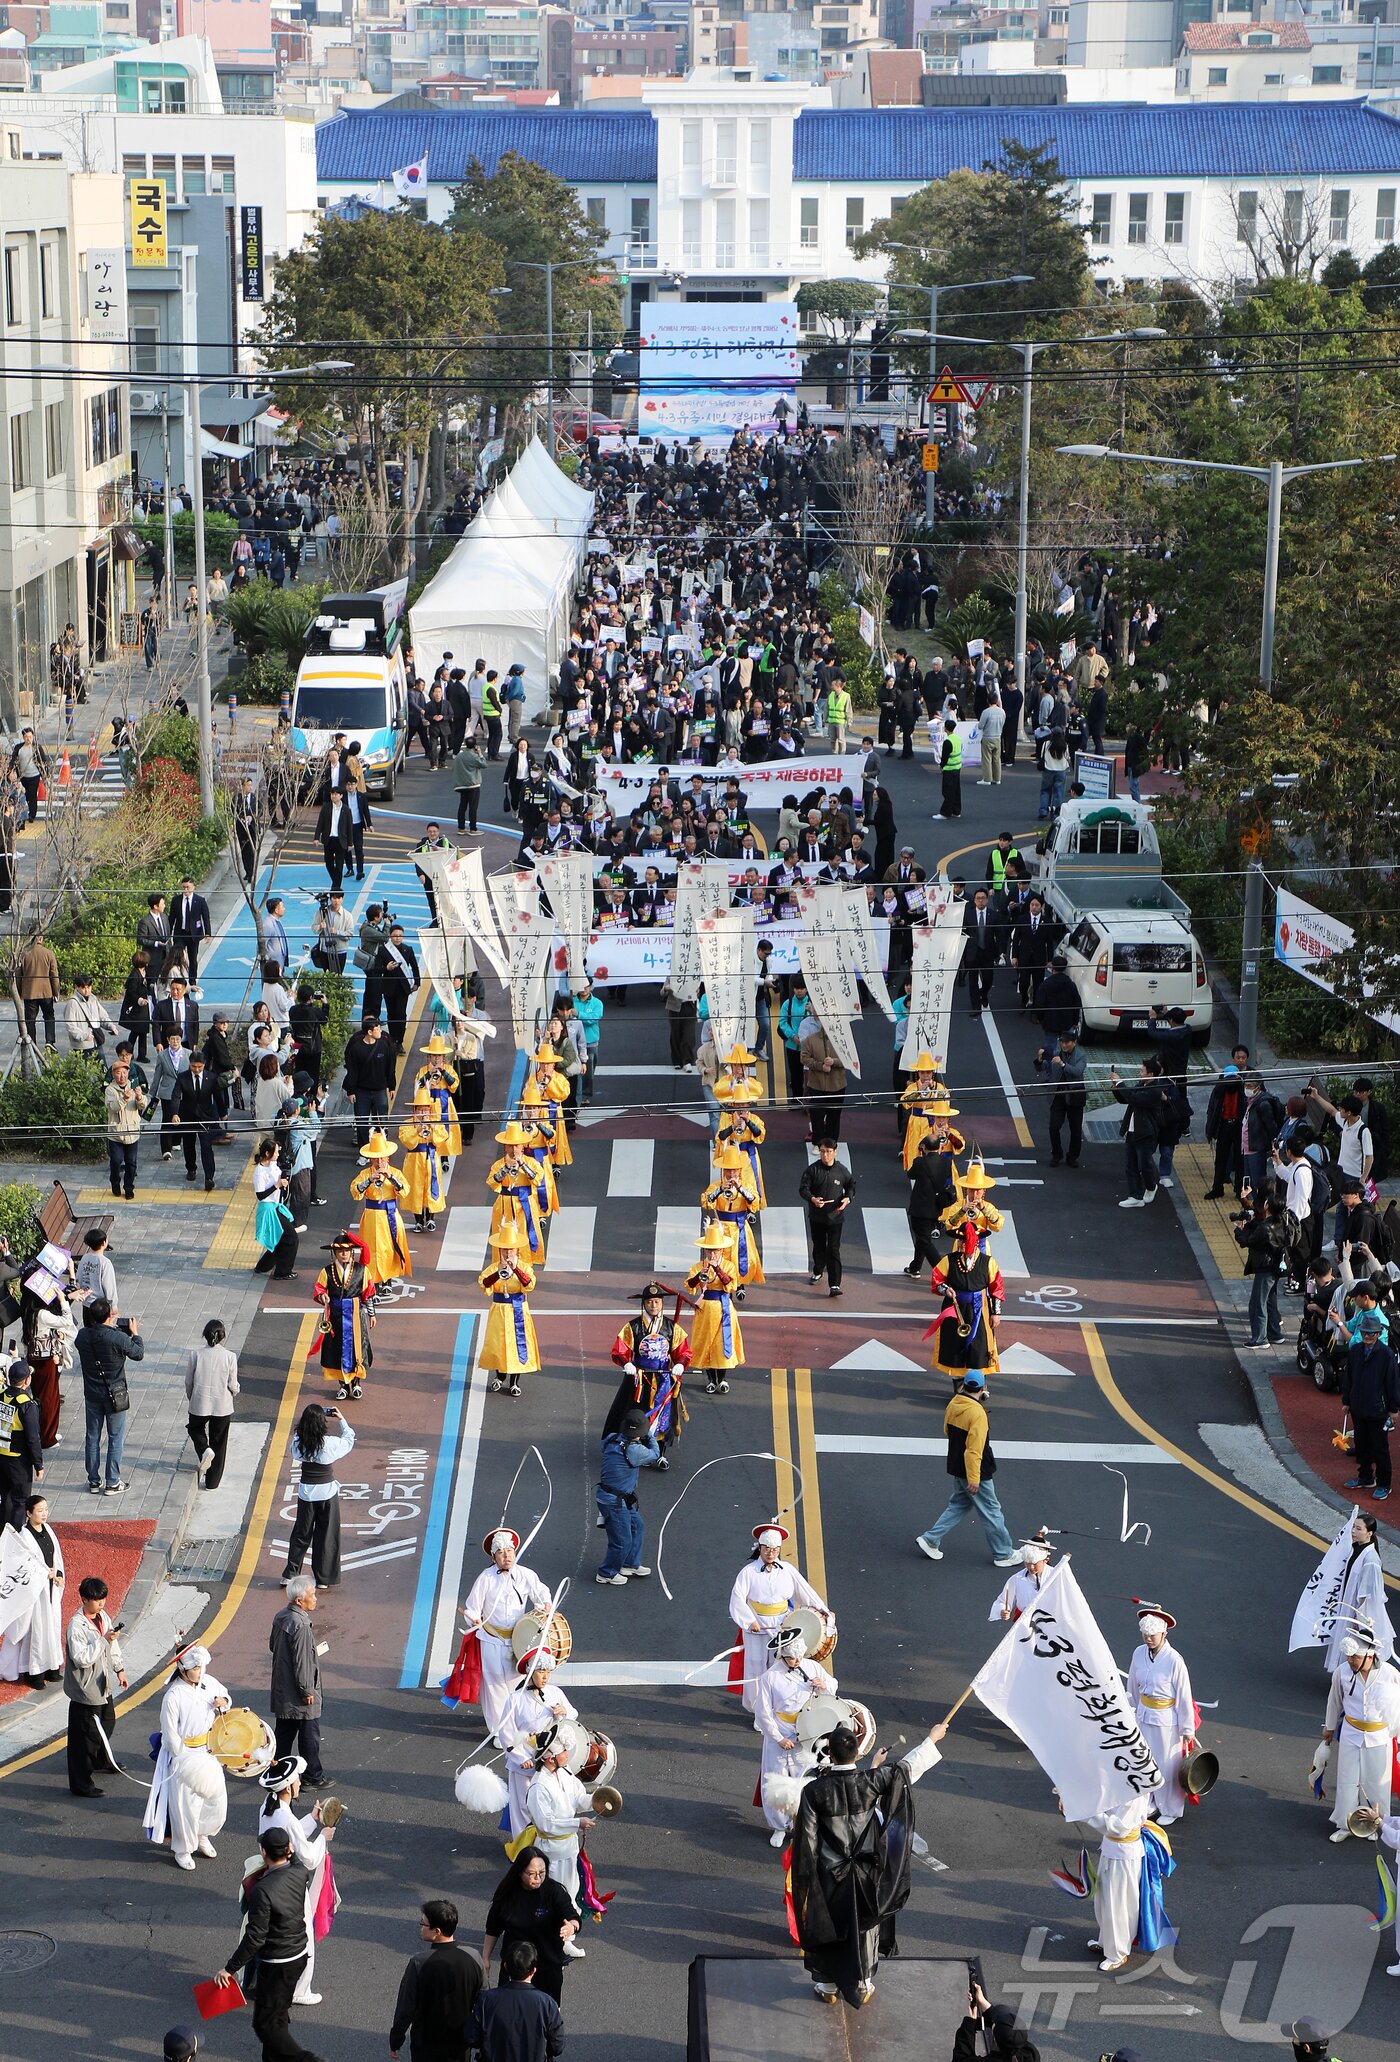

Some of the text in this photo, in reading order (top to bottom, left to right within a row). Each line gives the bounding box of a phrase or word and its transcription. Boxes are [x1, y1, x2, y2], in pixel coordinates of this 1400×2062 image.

[136, 185, 163, 243] 국수
[246, 207, 258, 234] 법무사
[135, 247, 165, 257] 전문집
[246, 235, 259, 269] 고은호
[94, 261, 118, 318] 아리랑
[248, 269, 259, 295] 사무소
[775, 767, 843, 783] 제정하라
[847, 903, 864, 938] 단결된
[512, 937, 528, 961] 역사
[616, 936, 650, 946] 거리에서
[1295, 928, 1308, 951] 차량
[1308, 936, 1321, 959] 통행
[523, 961, 536, 986] 왜곡
[806, 946, 820, 982] 평화와
[938, 951, 946, 978] 4·3
[934, 983, 944, 1008] 왜곡
